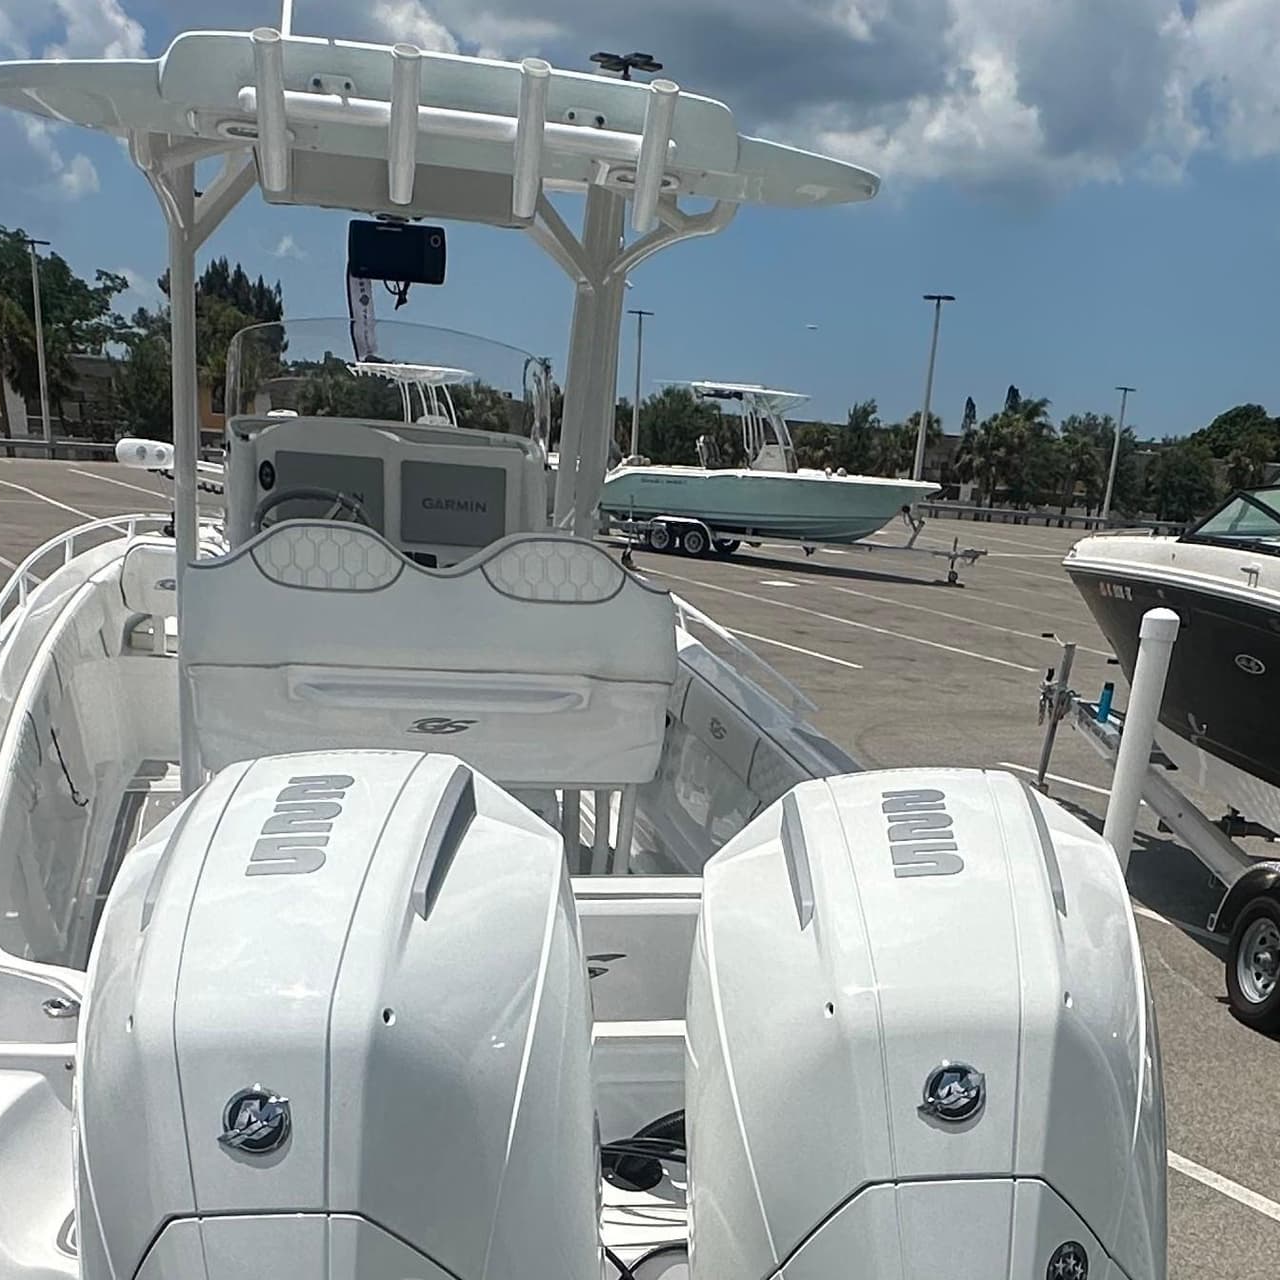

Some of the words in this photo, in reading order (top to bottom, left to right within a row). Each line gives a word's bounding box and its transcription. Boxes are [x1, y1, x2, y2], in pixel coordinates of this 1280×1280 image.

[422, 497, 487, 513] GARMIN
[245, 775, 355, 877] 225
[881, 789, 965, 878] 225
